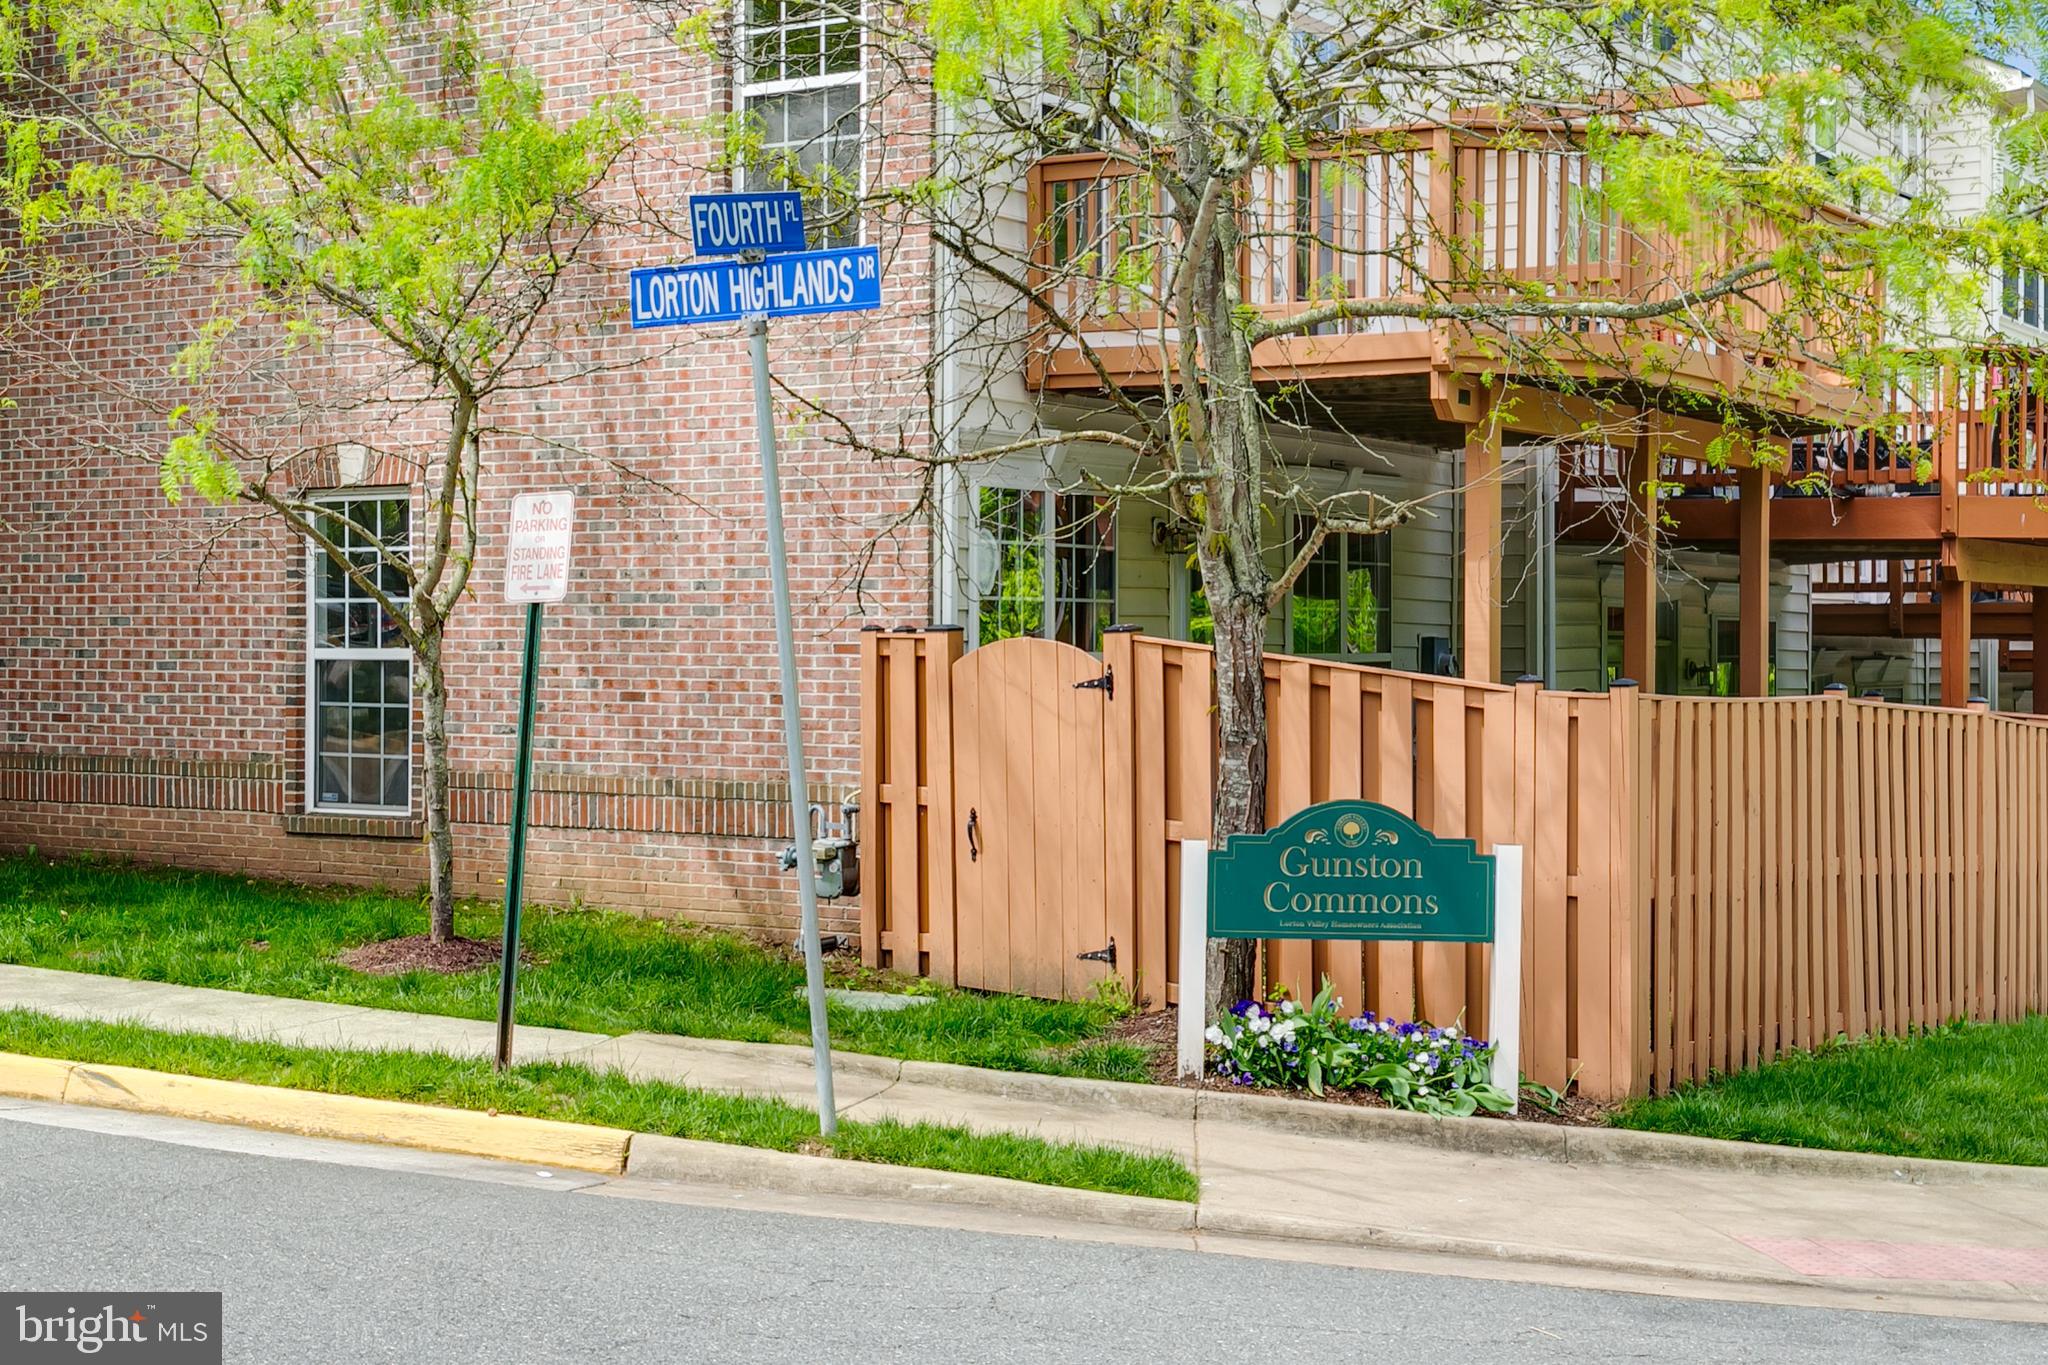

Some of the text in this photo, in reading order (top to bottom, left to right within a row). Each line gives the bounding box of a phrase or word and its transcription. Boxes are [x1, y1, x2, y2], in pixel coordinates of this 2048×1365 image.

[693, 199, 800, 247] FOURTH PL
[635, 255, 876, 320] LORTON HIGHLANDS DR
[532, 501, 552, 515] NO
[515, 517, 568, 533] PARKING
[513, 546, 566, 561] STANDING
[511, 563, 564, 580] FIRE LANE
[1279, 846, 1423, 878] Gunston
[1263, 881, 1439, 915] Commons
[1279, 919, 1422, 930] Lorton Valley Homeowners Association
